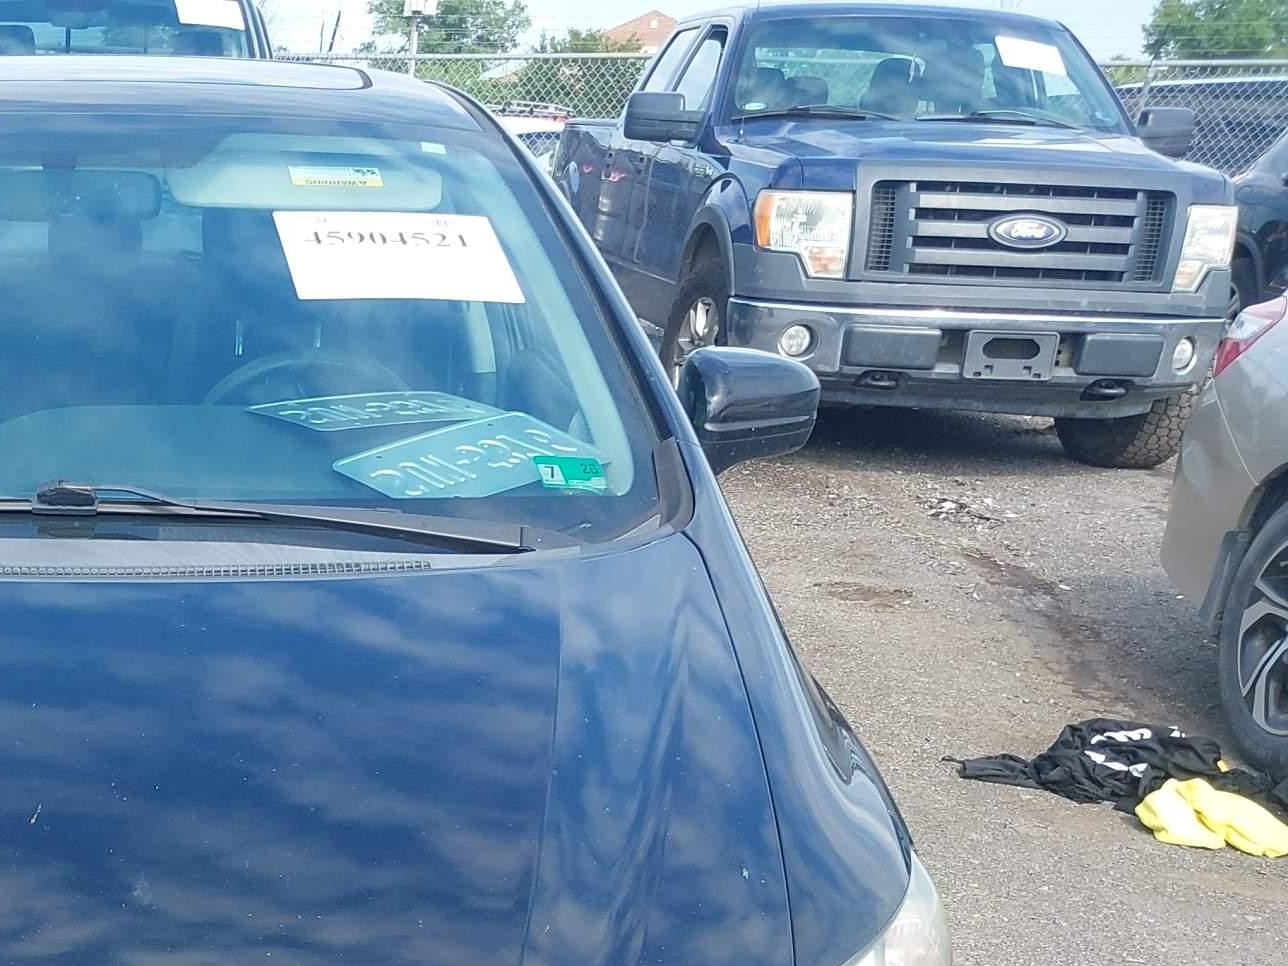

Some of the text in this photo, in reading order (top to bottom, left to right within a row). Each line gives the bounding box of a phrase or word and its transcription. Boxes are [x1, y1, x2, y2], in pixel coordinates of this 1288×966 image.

[997, 220, 1048, 239] Ford
[305, 230, 469, 248] 45904521
[543, 465, 555, 480] 7
